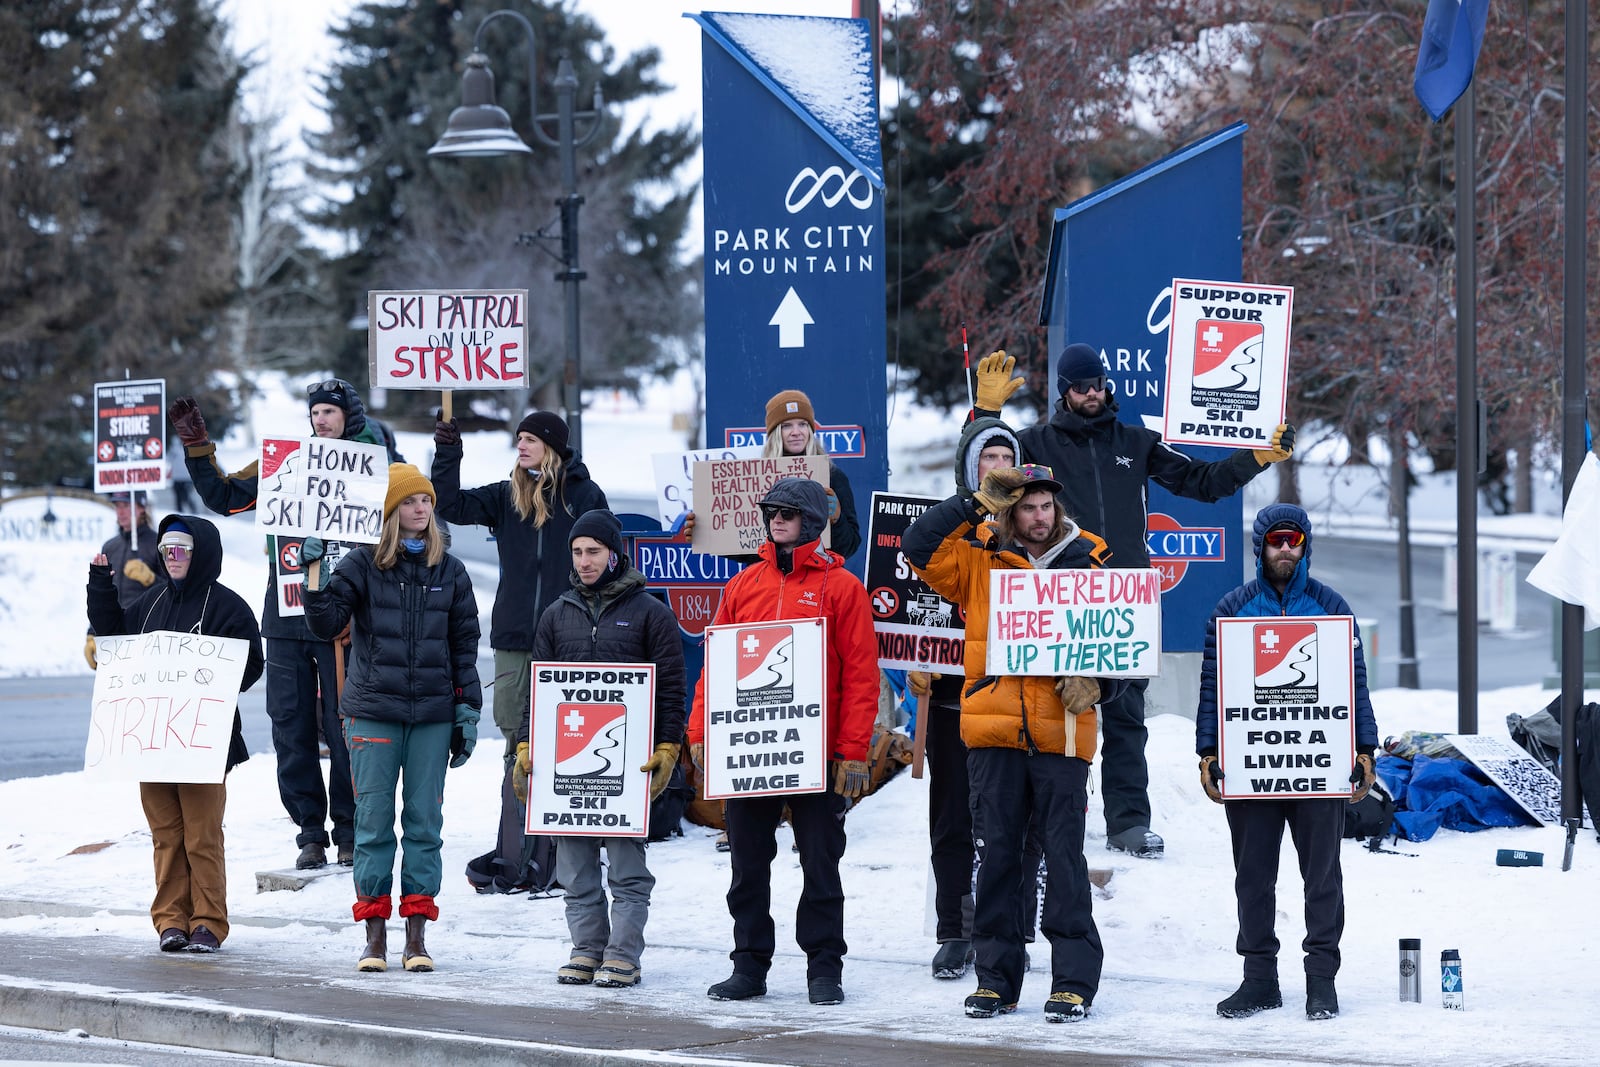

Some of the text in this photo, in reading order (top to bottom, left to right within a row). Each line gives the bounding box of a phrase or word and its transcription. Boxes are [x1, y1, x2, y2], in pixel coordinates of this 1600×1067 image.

[714, 225, 874, 252] PARK CITY
[714, 255, 873, 276] MOUNTAIN
[1179, 287, 1286, 306] SUPPORT
[378, 295, 523, 331] SKI PATROL
[1201, 306, 1263, 322] YOUR
[428, 330, 494, 349] ON ULP
[390, 342, 524, 382] STRIKE
[1100, 348, 1152, 372] ARK
[1220, 391, 1259, 399] PROFESSIONAL
[1206, 408, 1243, 423] SKI
[109, 415, 150, 437] STRIKE
[1180, 422, 1267, 440] PATROL
[820, 431, 859, 452] ITY
[307, 443, 374, 477] HONK
[711, 459, 782, 479] ESSENTIAL
[787, 464, 808, 473] THE
[792, 457, 805, 465] TO
[99, 467, 161, 486] UNION STRONG
[306, 476, 347, 501] FOR
[711, 494, 743, 513] AND
[878, 501, 928, 517] PARK CITY
[263, 497, 383, 537] SKI PATROL
[712, 510, 759, 531] OF OUR
[877, 534, 901, 548] UNFA
[1162, 532, 1219, 555] CITY
[640, 546, 696, 579] PARK
[999, 570, 1160, 606] IF WE'RE DOWN
[678, 594, 712, 620] 1884
[997, 607, 1135, 643] HERE, WHO'S
[99, 634, 235, 666] SKI PATROL
[878, 631, 917, 662] NION
[1006, 641, 1150, 673] UP THERE?
[108, 670, 188, 689] IS ON ULP
[538, 670, 648, 685] SUPPORT
[561, 688, 625, 703] YOUR
[710, 703, 821, 725] FIGHTING
[1225, 705, 1349, 722] FIGHTING
[88, 696, 226, 768] STRIKE
[729, 728, 801, 746] FOR A
[1247, 730, 1327, 745] FOR A
[726, 750, 804, 770] LIVING
[1244, 753, 1332, 769] LIVING
[731, 774, 800, 792] WAGE
[1250, 777, 1327, 792] WAGE
[569, 796, 608, 810] SKI
[543, 812, 631, 827] PATROL
[1513, 850, 1528, 860] JBL
